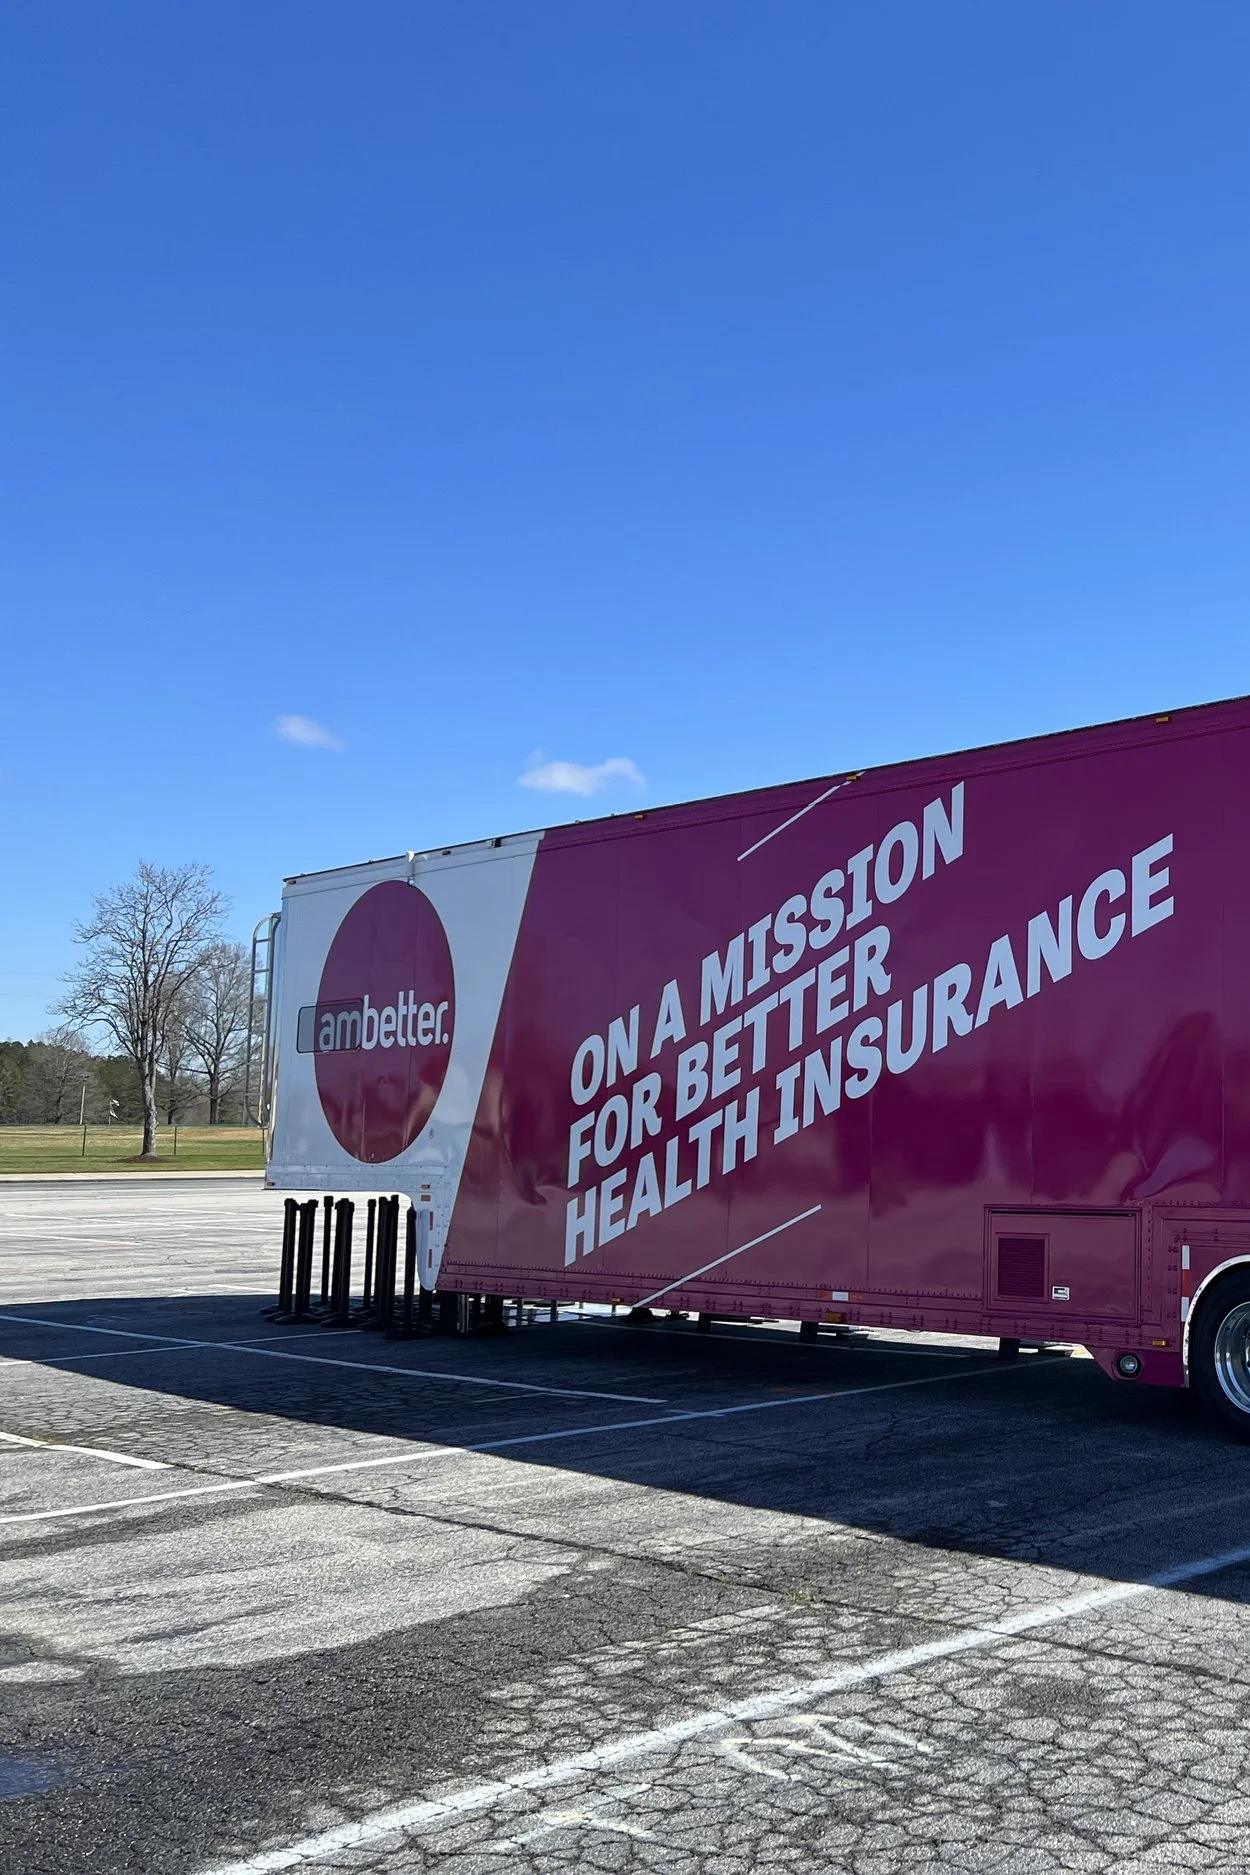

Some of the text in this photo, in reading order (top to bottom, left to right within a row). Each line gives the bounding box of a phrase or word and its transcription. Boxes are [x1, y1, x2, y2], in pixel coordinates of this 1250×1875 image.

[318, 989, 449, 1053] ambetter.
[565, 834, 1173, 1266] HEALTH INSURANCE
[568, 926, 891, 1188] FOR BETTER
[571, 781, 964, 1105] ON A MISSION
